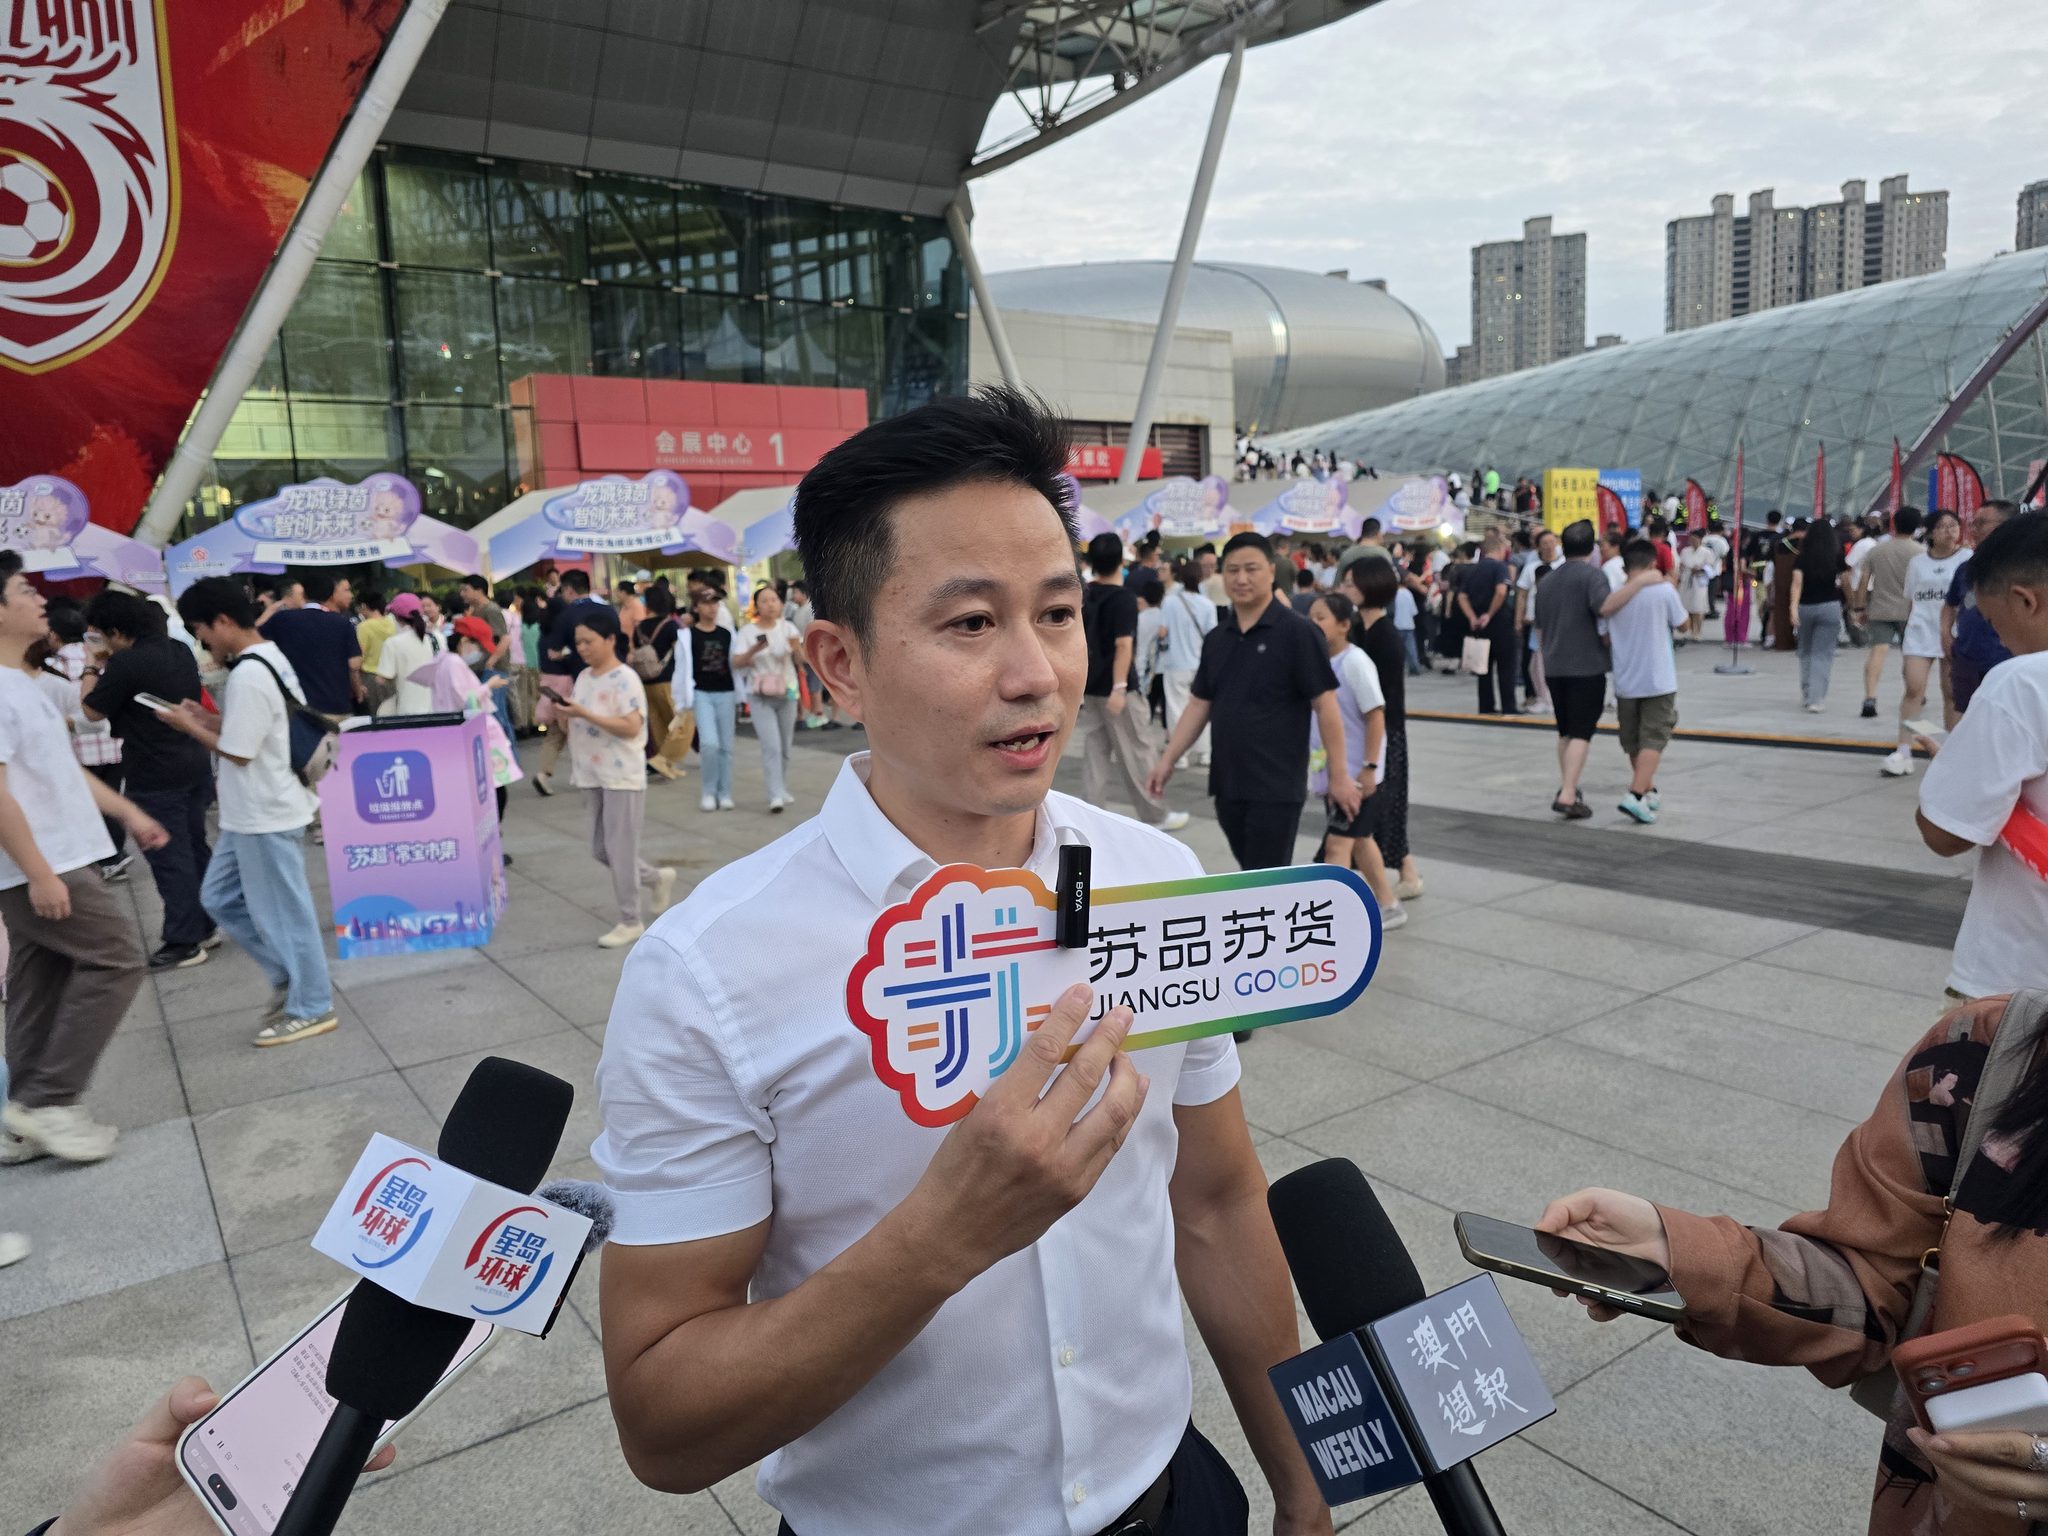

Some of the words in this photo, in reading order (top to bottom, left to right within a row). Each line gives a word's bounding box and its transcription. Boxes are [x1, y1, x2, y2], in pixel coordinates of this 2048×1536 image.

[656, 430, 752, 455] 会展中心
[768, 431, 784, 467] 1
[273, 512, 355, 540] 智创未来
[1075, 881, 1084, 912] BOYA
[1088, 900, 1336, 984] 苏品苏货
[1090, 976, 1220, 1021] JIANGSU
[1234, 960, 1337, 996] GOODS
[376, 1174, 428, 1219] 星岛
[358, 1205, 410, 1246] 环球
[491, 1224, 547, 1264] 星岛
[474, 1256, 532, 1292] 环球
[1406, 1299, 1492, 1376] 澳門
[1291, 1364, 1363, 1425] MACAU
[1438, 1366, 1528, 1436] 週報
[1311, 1418, 1394, 1480] WEEKLY
